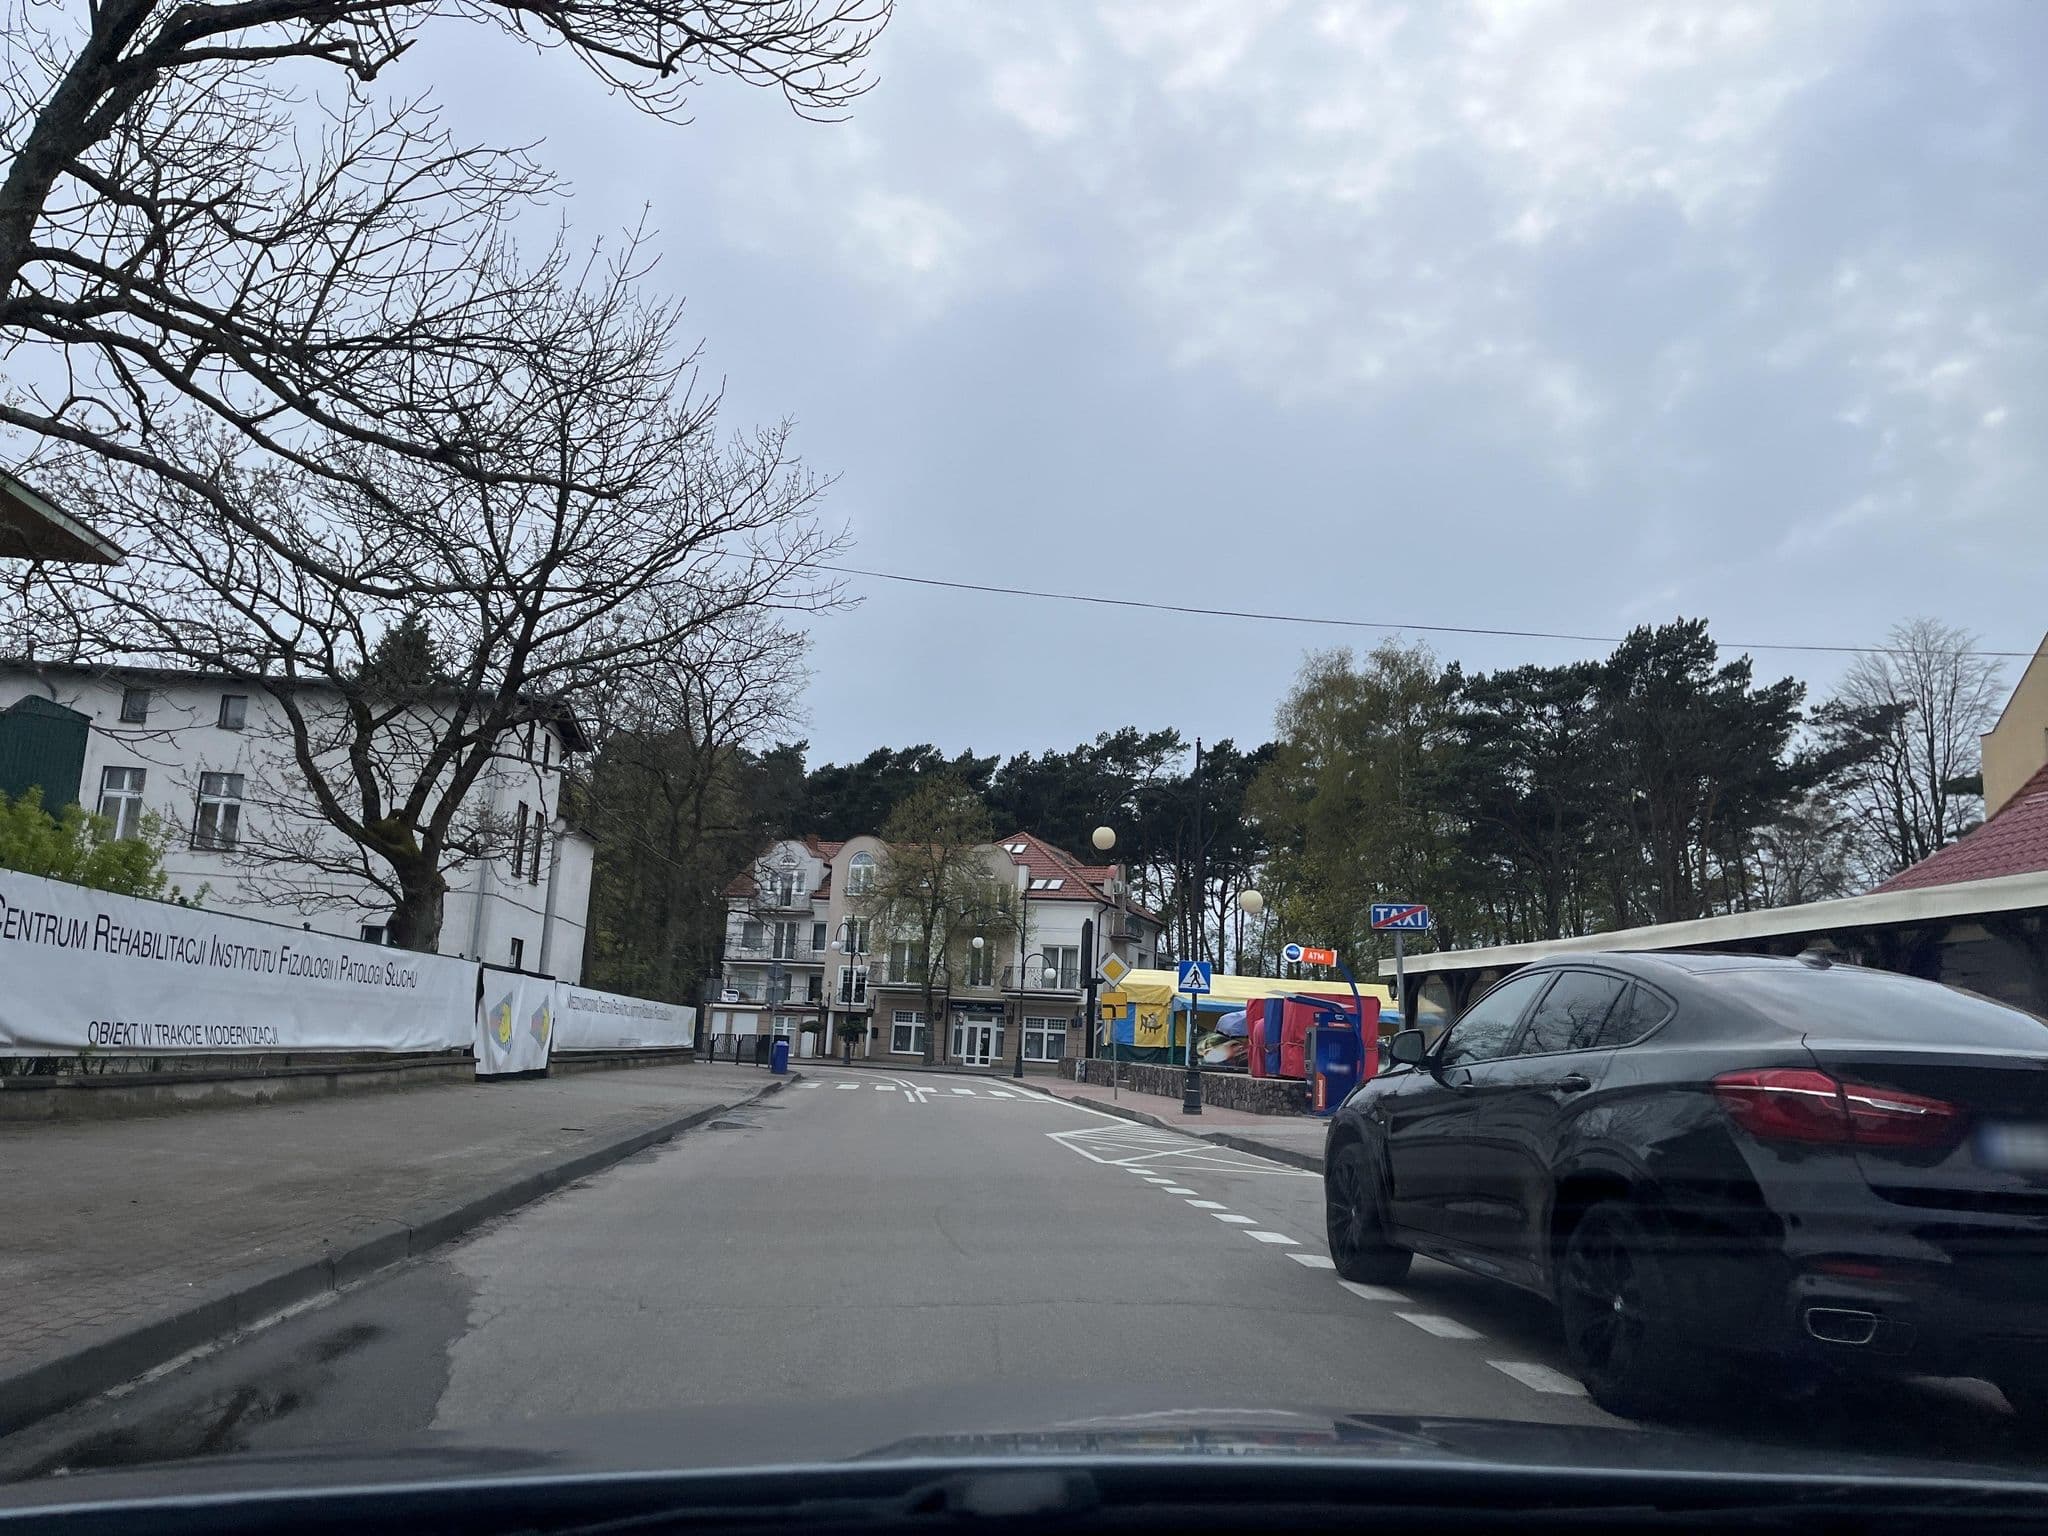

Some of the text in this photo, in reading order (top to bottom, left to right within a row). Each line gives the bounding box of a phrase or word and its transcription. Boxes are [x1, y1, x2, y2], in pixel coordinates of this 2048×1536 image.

[1375, 908, 1423, 926] TAXI
[93, 914, 207, 966] REHABILITACJI
[210, 935, 277, 973] INSTYTUTU
[279, 946, 333, 980] FIZJOLOGII
[340, 955, 383, 985] PATOLOGII
[385, 962, 418, 988] SŁUCHU
[1307, 952, 1325, 961] ATM
[88, 1021, 279, 1046] OBIEKT W TRAKCIE MODERNIZACJI
